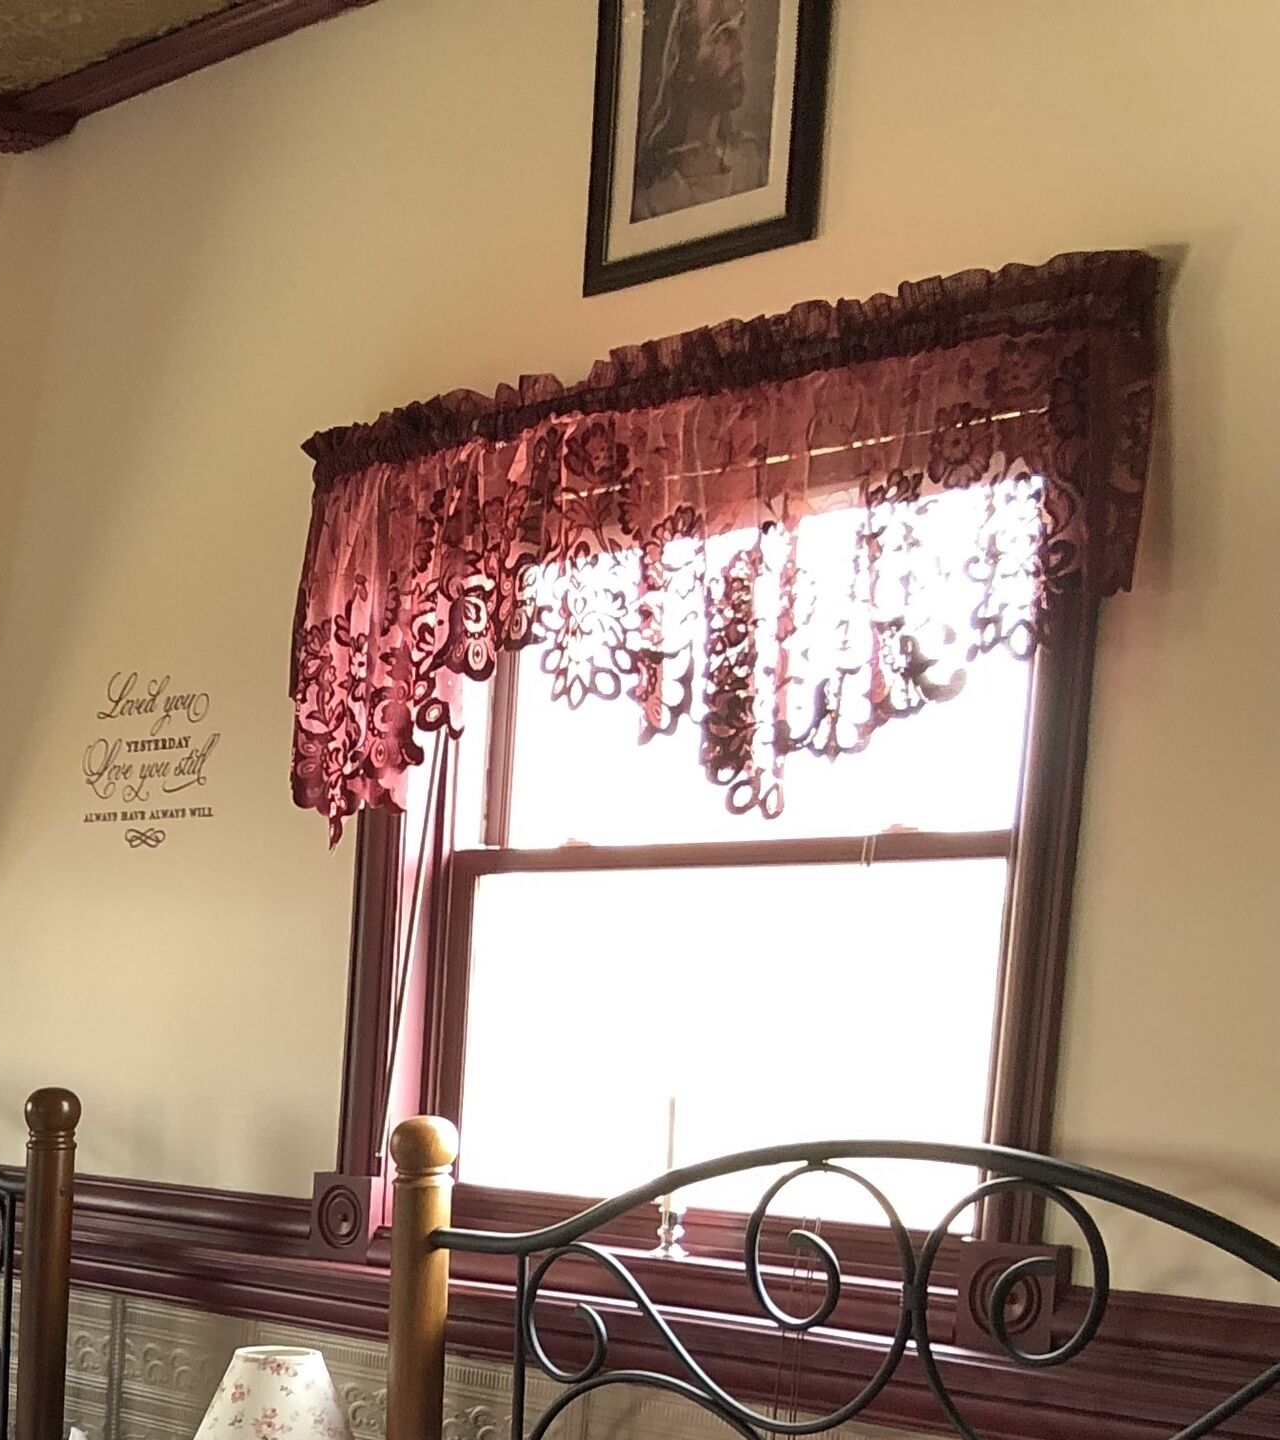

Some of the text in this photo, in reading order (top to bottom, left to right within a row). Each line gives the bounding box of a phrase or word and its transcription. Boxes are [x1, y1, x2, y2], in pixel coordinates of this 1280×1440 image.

[97, 671, 210, 736] Loved you
[126, 736, 191, 753] YESTERDAY
[82, 733, 221, 803] Love you still
[83, 807, 213, 823] ALWAYS HAVE ALWAYS WILL
